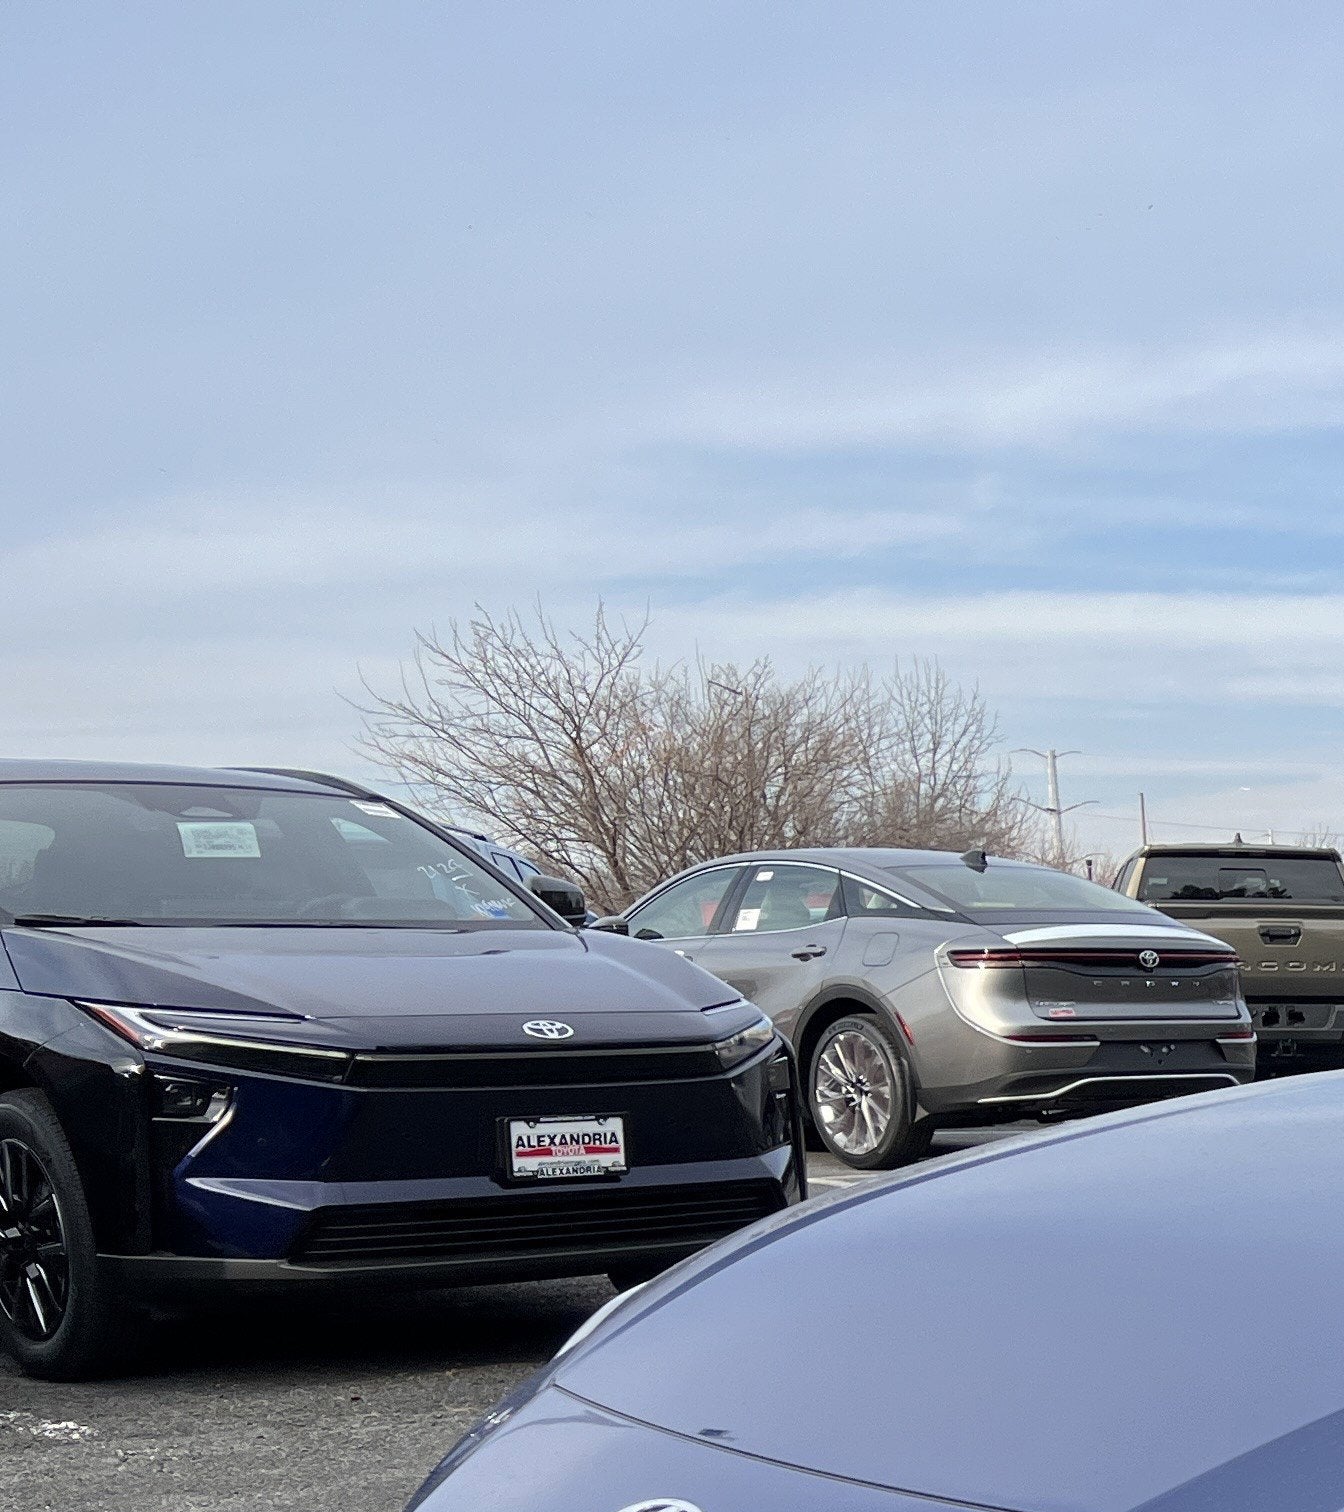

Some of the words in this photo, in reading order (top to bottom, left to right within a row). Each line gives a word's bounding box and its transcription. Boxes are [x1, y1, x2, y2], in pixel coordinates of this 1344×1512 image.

[516, 1132, 619, 1148] ALEXANDRIA
[551, 1145, 587, 1157] TOYOTA
[539, 1166, 601, 1176] ALEXANDRIA
